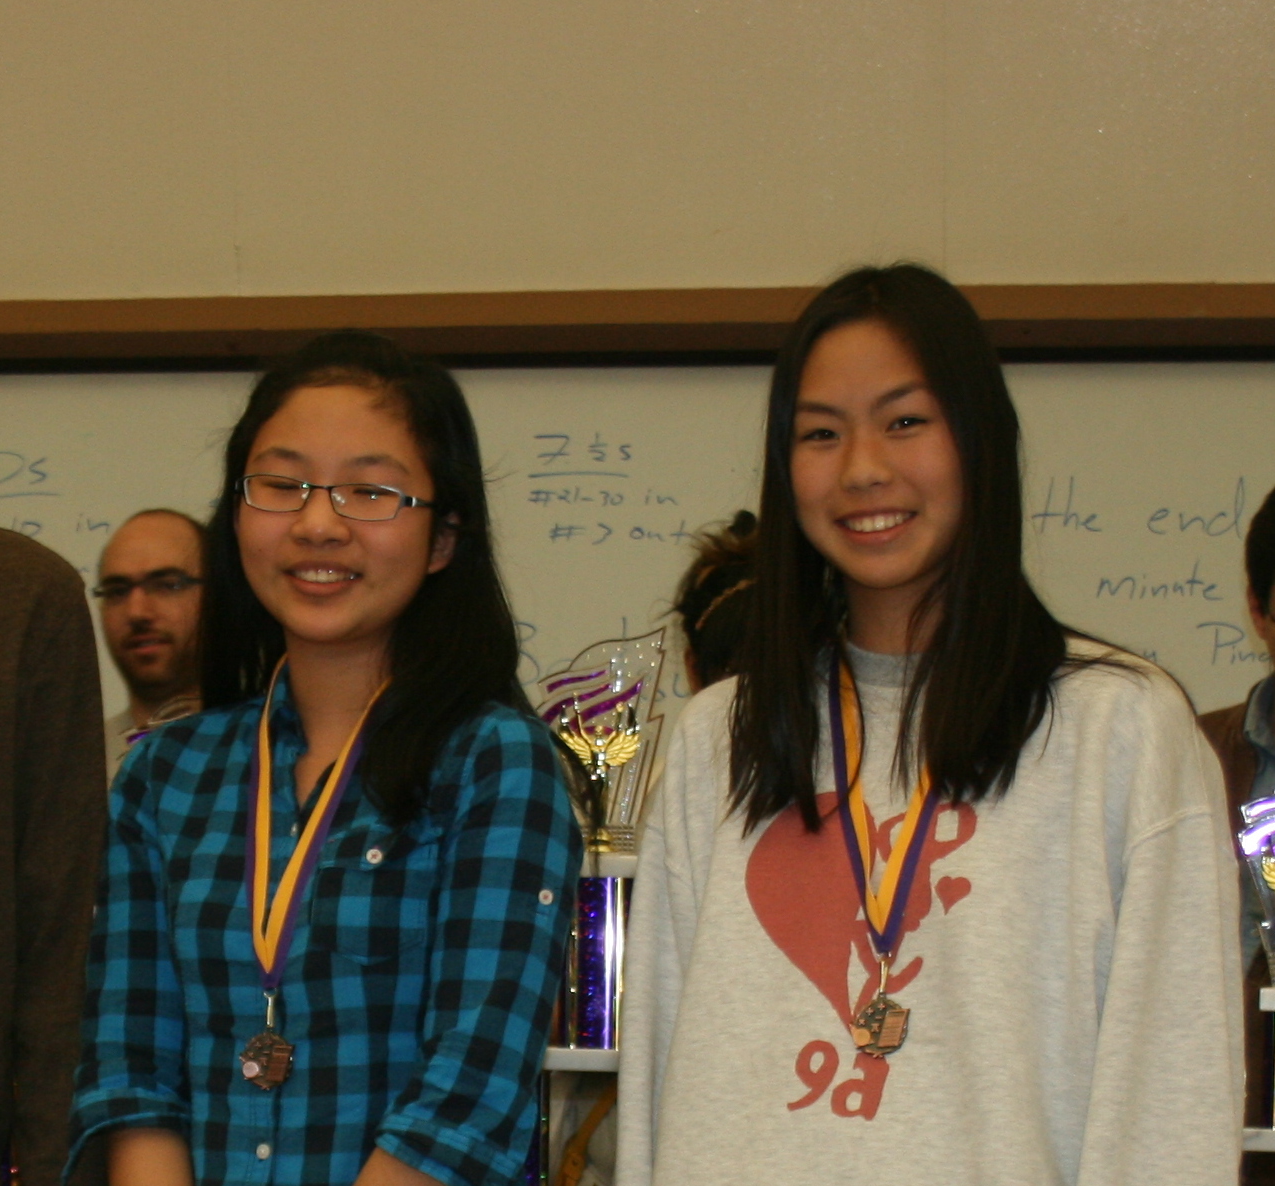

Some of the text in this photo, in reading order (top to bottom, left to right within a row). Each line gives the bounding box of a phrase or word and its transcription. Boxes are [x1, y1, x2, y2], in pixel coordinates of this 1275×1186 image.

[644, 489, 678, 506] in
[1032, 475, 1245, 538] the end
[629, 521, 692, 543] out
